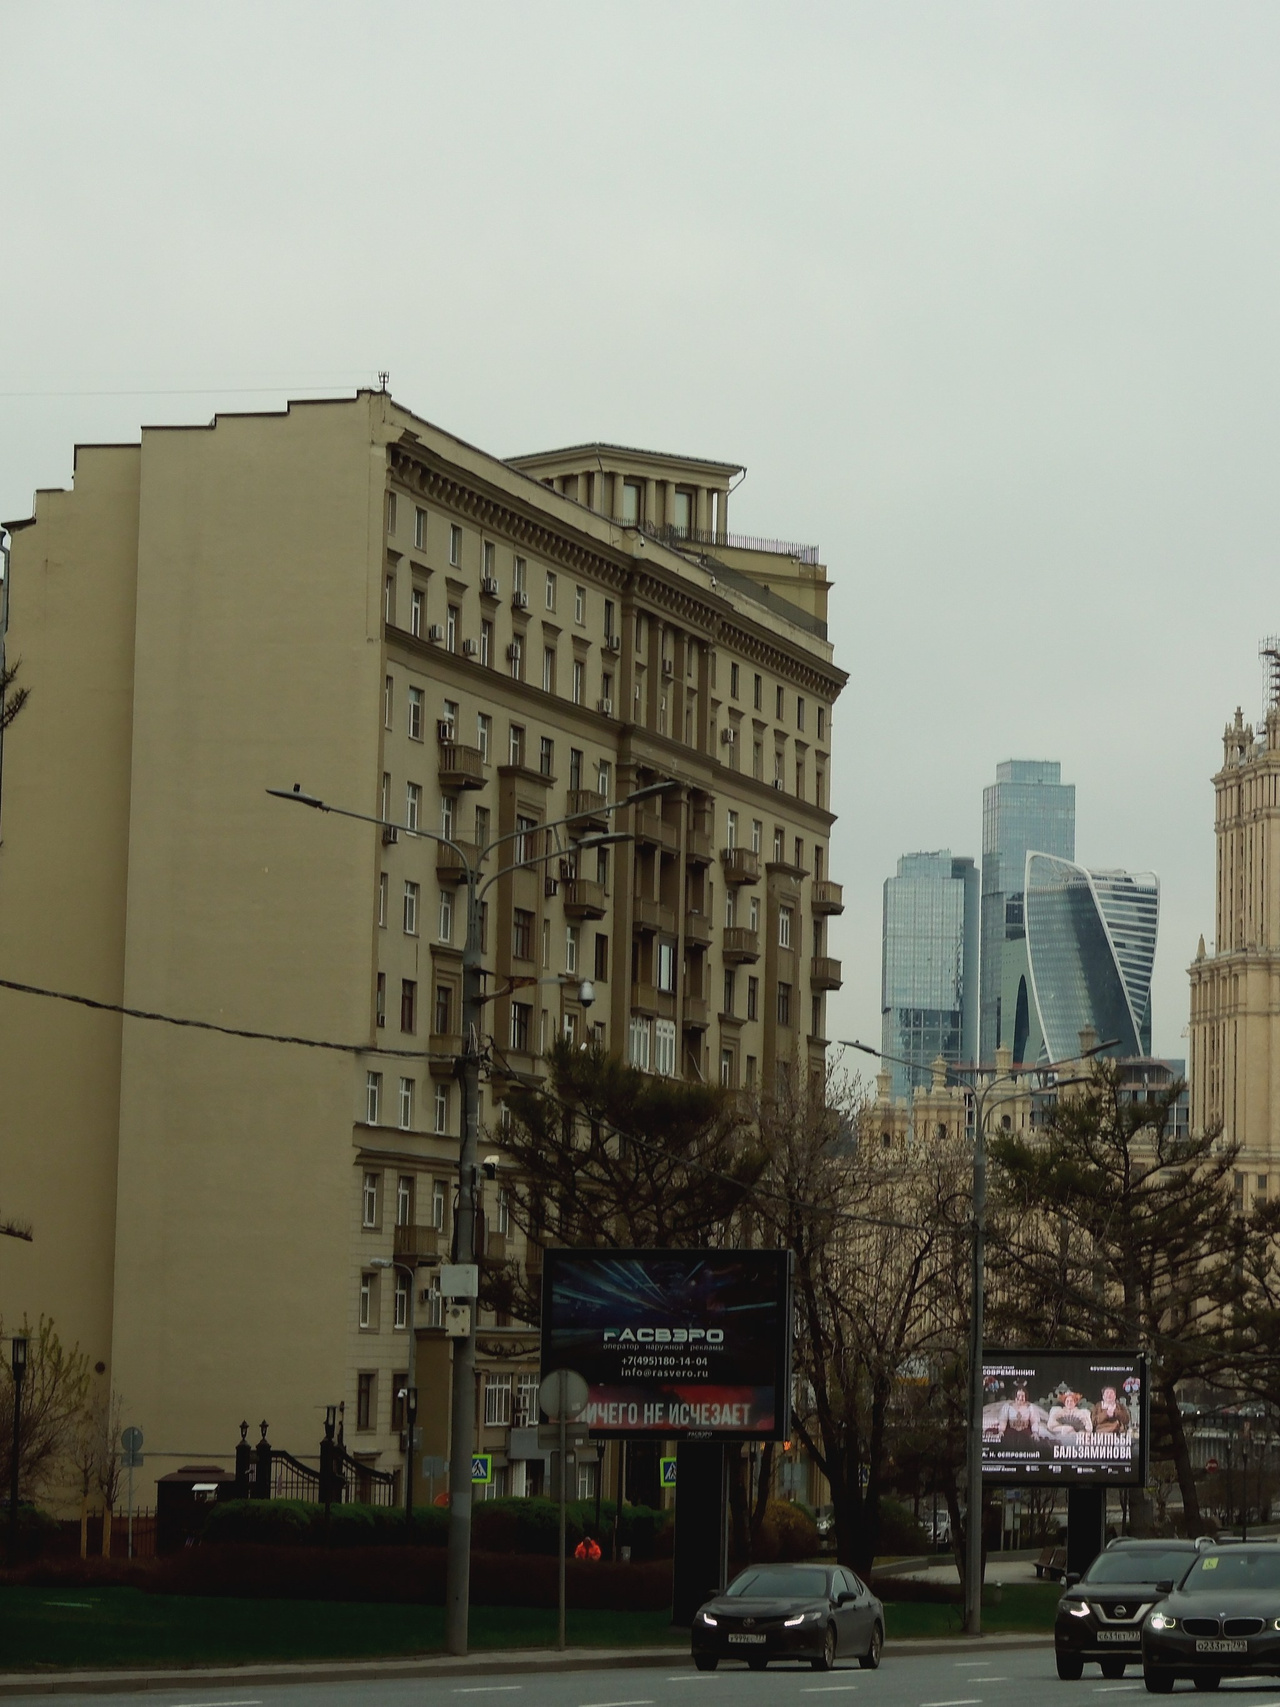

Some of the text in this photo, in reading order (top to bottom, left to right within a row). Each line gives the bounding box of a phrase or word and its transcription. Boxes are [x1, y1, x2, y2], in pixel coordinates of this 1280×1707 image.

[603, 1328, 724, 1343] РАСВЭРО
[603, 1343, 724, 1352] оператор наружной рекламы
[621, 1356, 708, 1367] +7(495)180-14-04
[621, 1367, 709, 1378] info@rasvero.ru
[643, 1403, 664, 1424] НЕ
[668, 1403, 751, 1425] ИСЧЕЗАЕТ
[1076, 1432, 1131, 1446] ЖЕНИТЬБА
[1053, 1445, 1131, 1459] БАЛЬЗАМИНОВА
